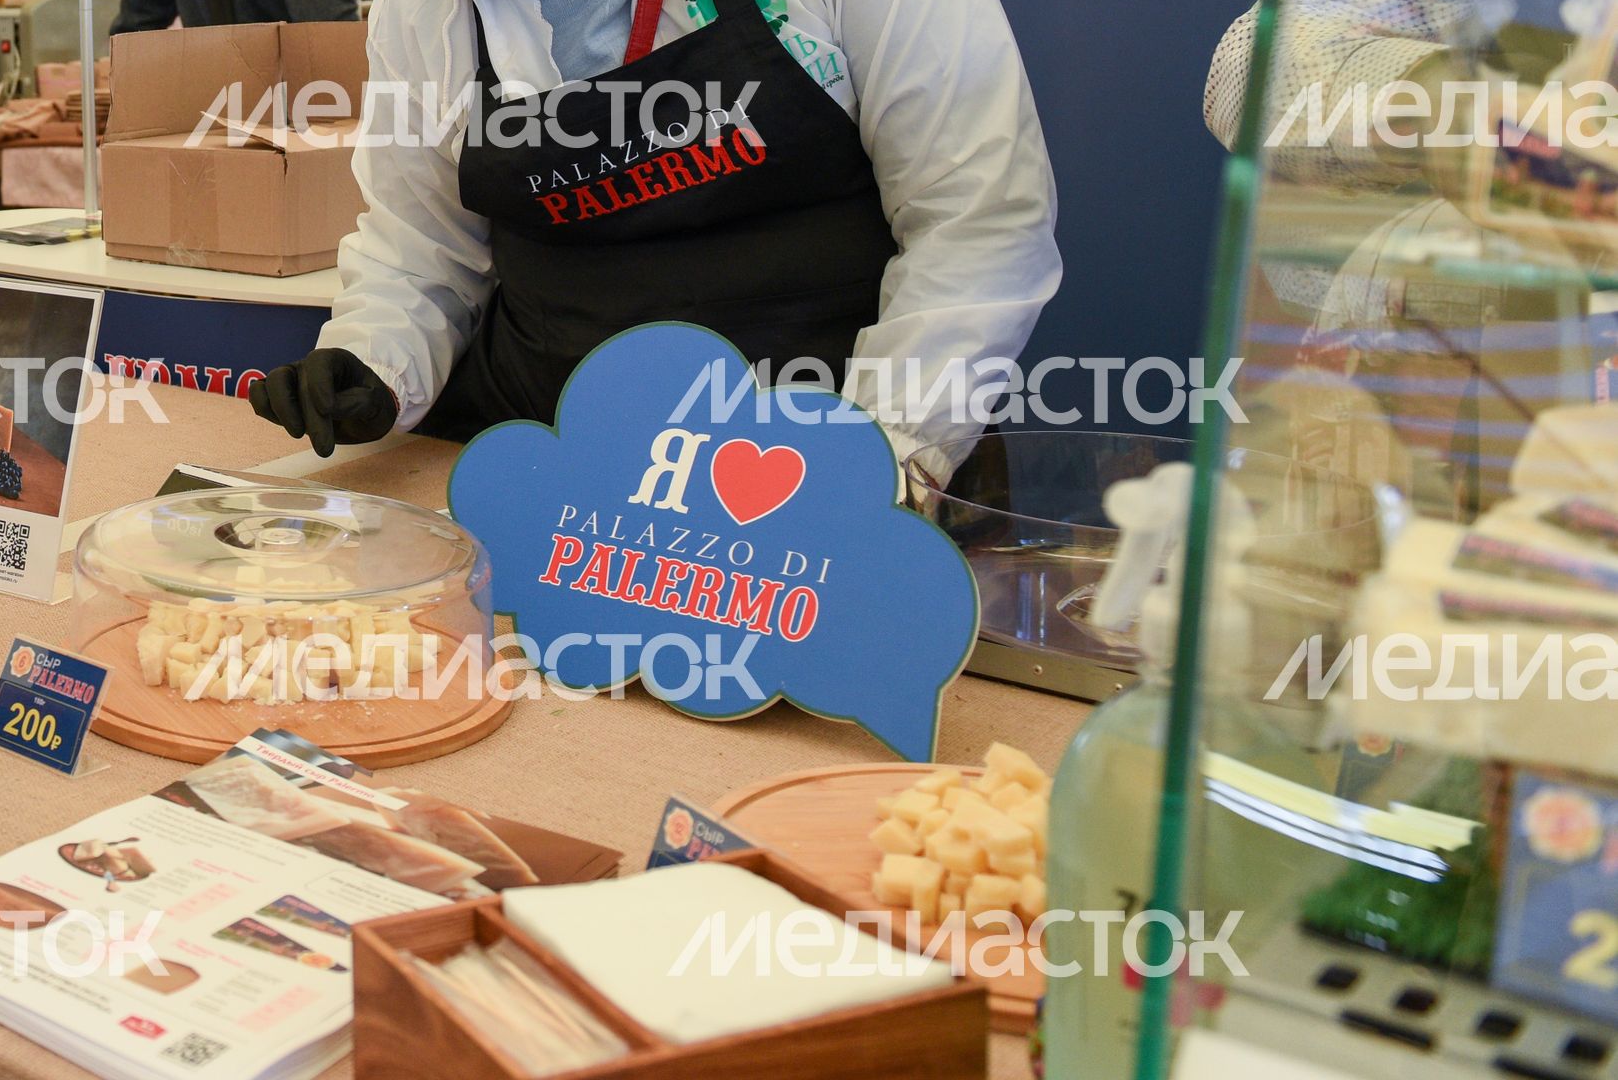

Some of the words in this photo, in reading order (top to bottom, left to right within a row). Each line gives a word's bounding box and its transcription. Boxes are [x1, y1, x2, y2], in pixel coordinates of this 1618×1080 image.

[526, 122, 688, 193] PALAZZO
[706, 99, 751, 130] DI
[535, 127, 767, 225] PALERMO
[627, 427, 712, 514] Я
[556, 503, 755, 567] PALAZZO
[780, 550, 834, 584] DI
[538, 532, 820, 643] PALERMO
[27, 665, 95, 704] PALERMO
[36, 653, 61, 668] СЫР
[695, 822, 725, 845] СЫР
